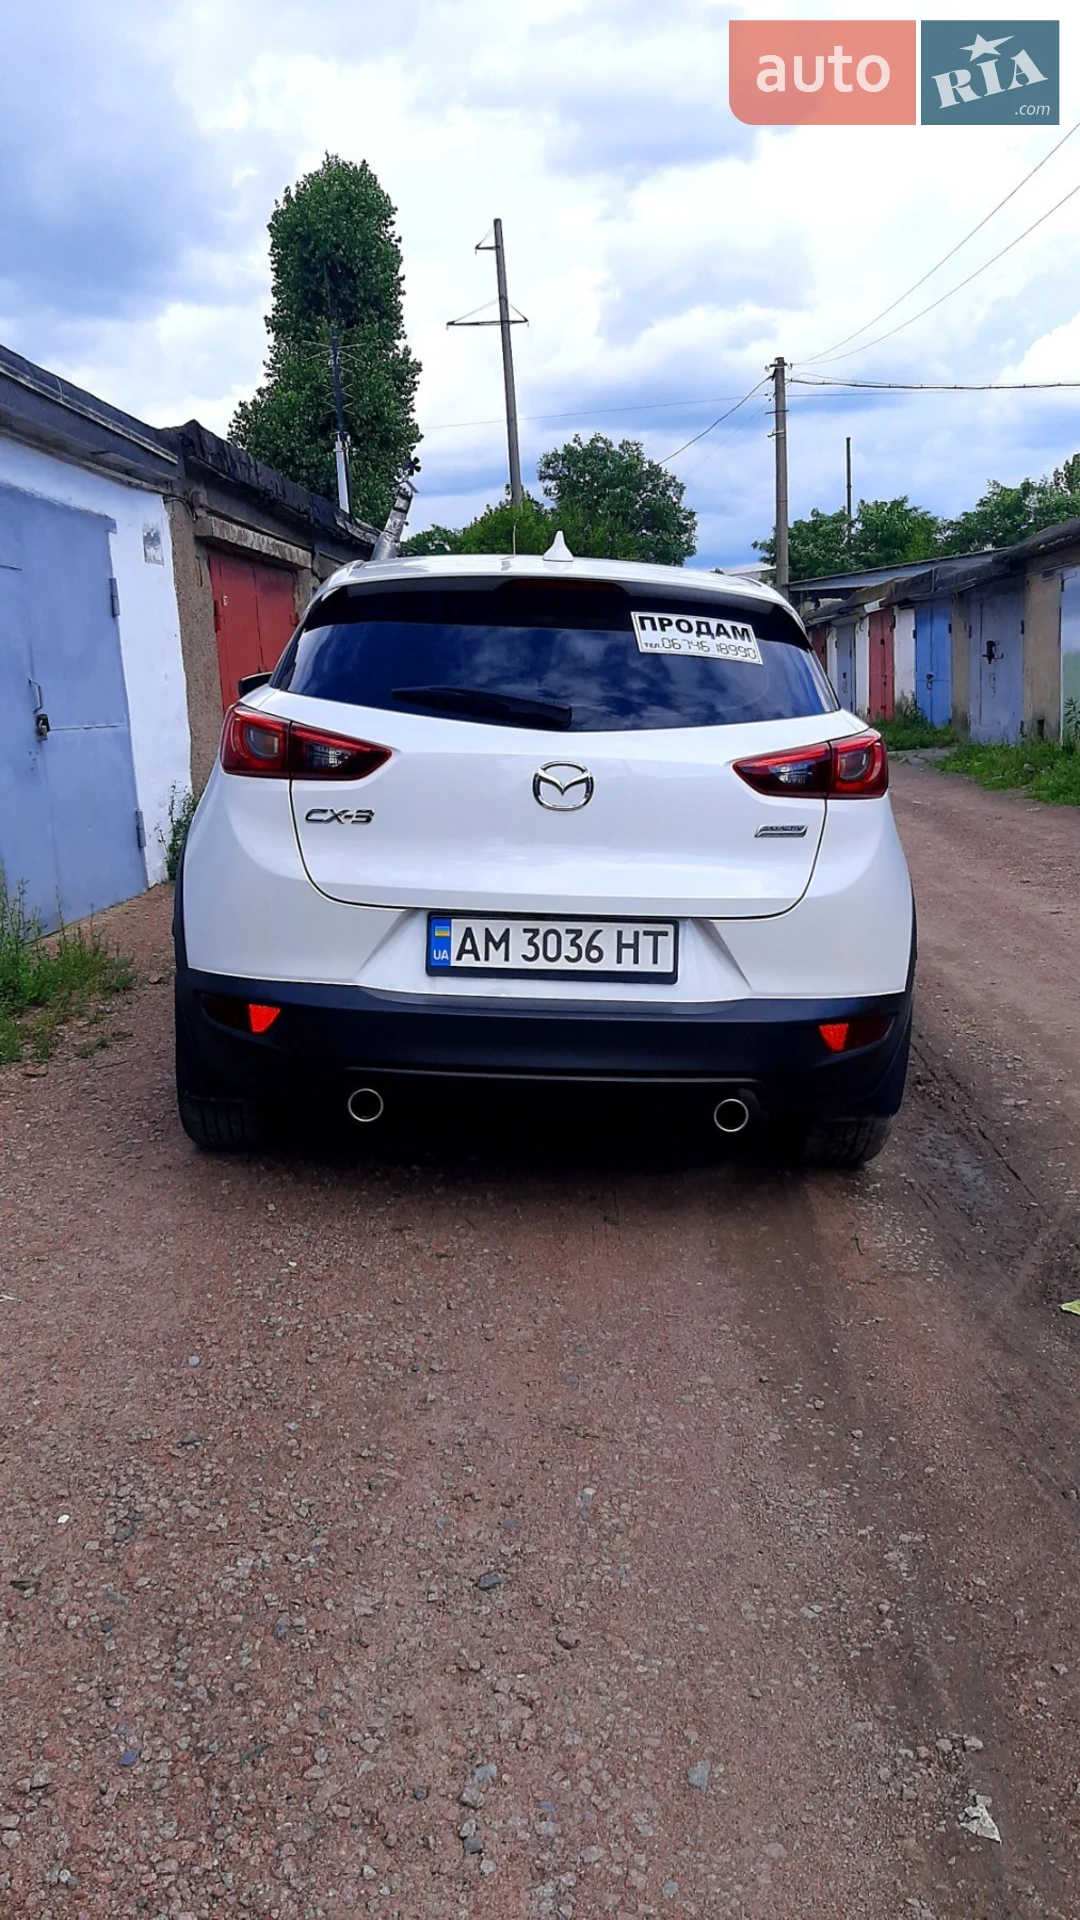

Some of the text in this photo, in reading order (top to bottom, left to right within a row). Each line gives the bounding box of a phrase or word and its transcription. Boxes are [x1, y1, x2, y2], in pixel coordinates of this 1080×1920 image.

[638, 616, 752, 643] ПРОДАМ
[305, 808, 374, 824] CX-3
[433, 949, 449, 960] UA
[455, 926, 669, 965] AM 3036 HT
